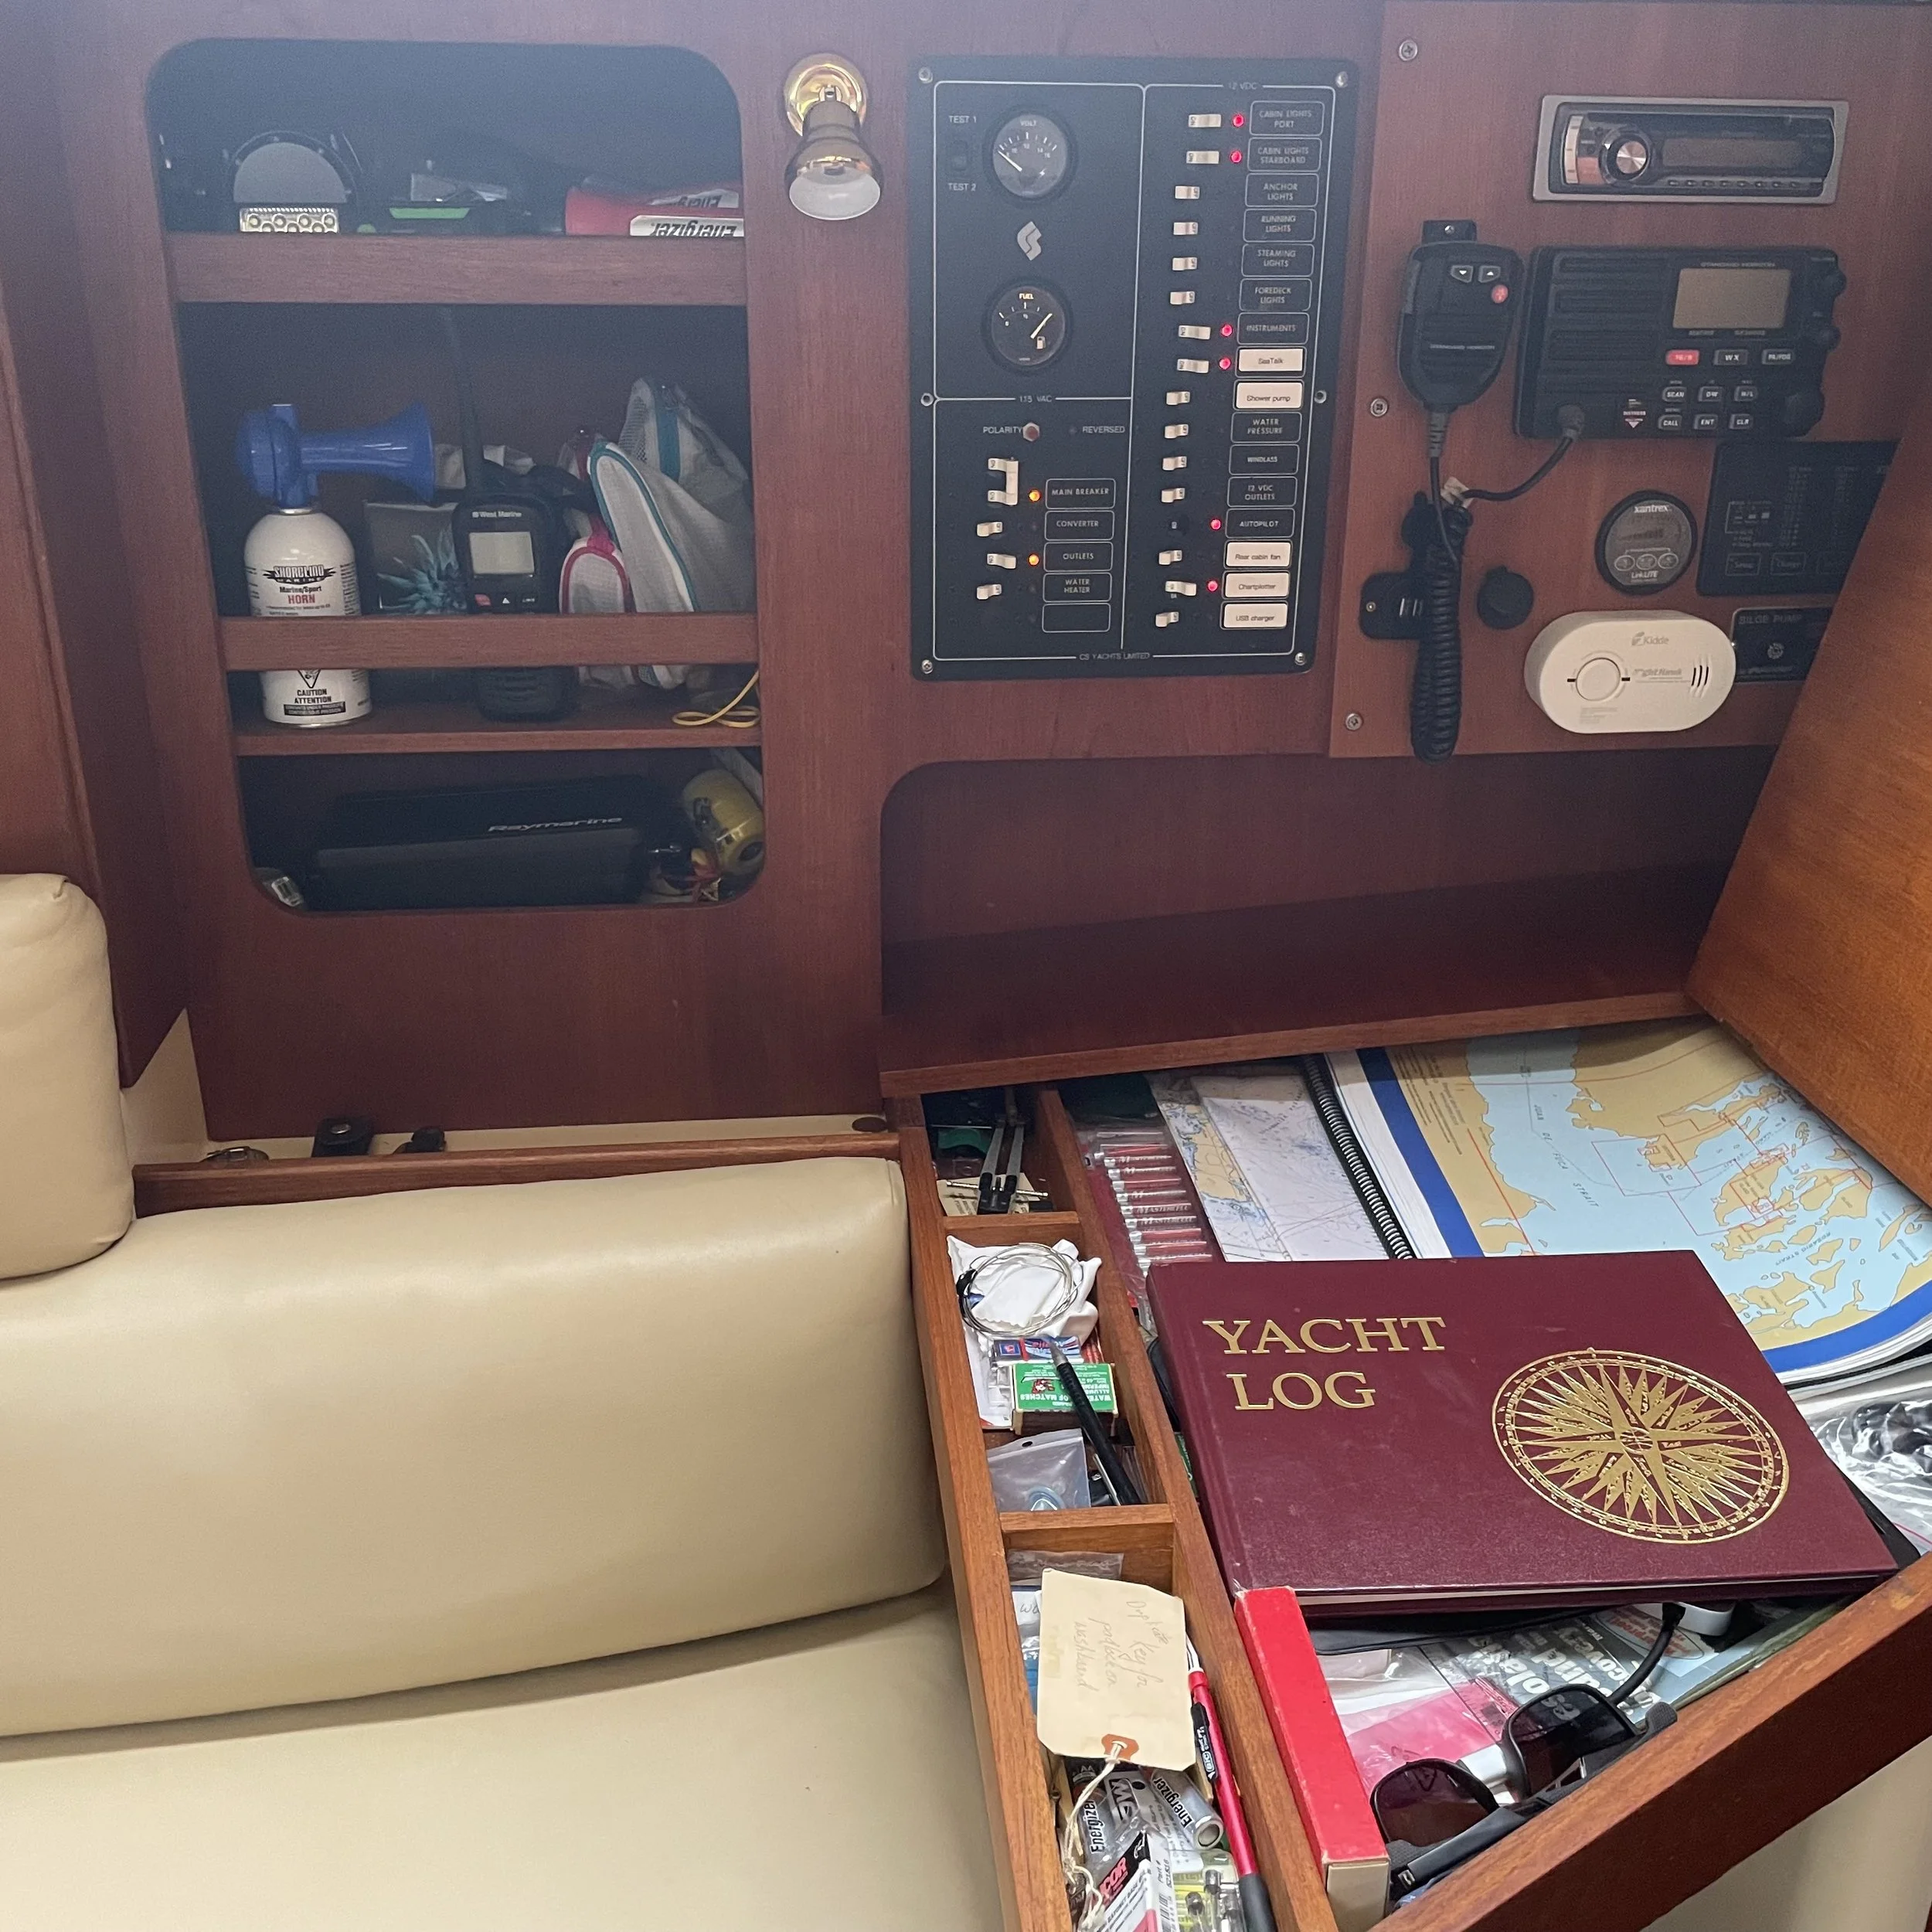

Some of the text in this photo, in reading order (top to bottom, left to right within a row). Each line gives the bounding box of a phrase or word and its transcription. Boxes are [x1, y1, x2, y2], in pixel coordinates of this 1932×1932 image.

[948, 115, 970, 124] TEST
[947, 182, 969, 191] TEST
[1265, 224, 1291, 233] LIGHTS
[982, 426, 1022, 434] POLARITY
[1634, 504, 1668, 513] xantrex
[287, 594, 316, 604] HORN
[1644, 637, 1669, 645] Kidde
[297, 688, 328, 696] CAUTION
[488, 817, 623, 832] Raymarine
[1573, 1182, 1600, 1207] STRAIT
[1202, 1316, 1447, 1356] YACHT
[1226, 1371, 1378, 1413] LOG
[1020, 1393, 1063, 1402] MATCHES
[1202, 1751, 1214, 1772] BIC
[1152, 1776, 1193, 1828] Energizer
[1082, 1799, 1106, 1855] Energizer
